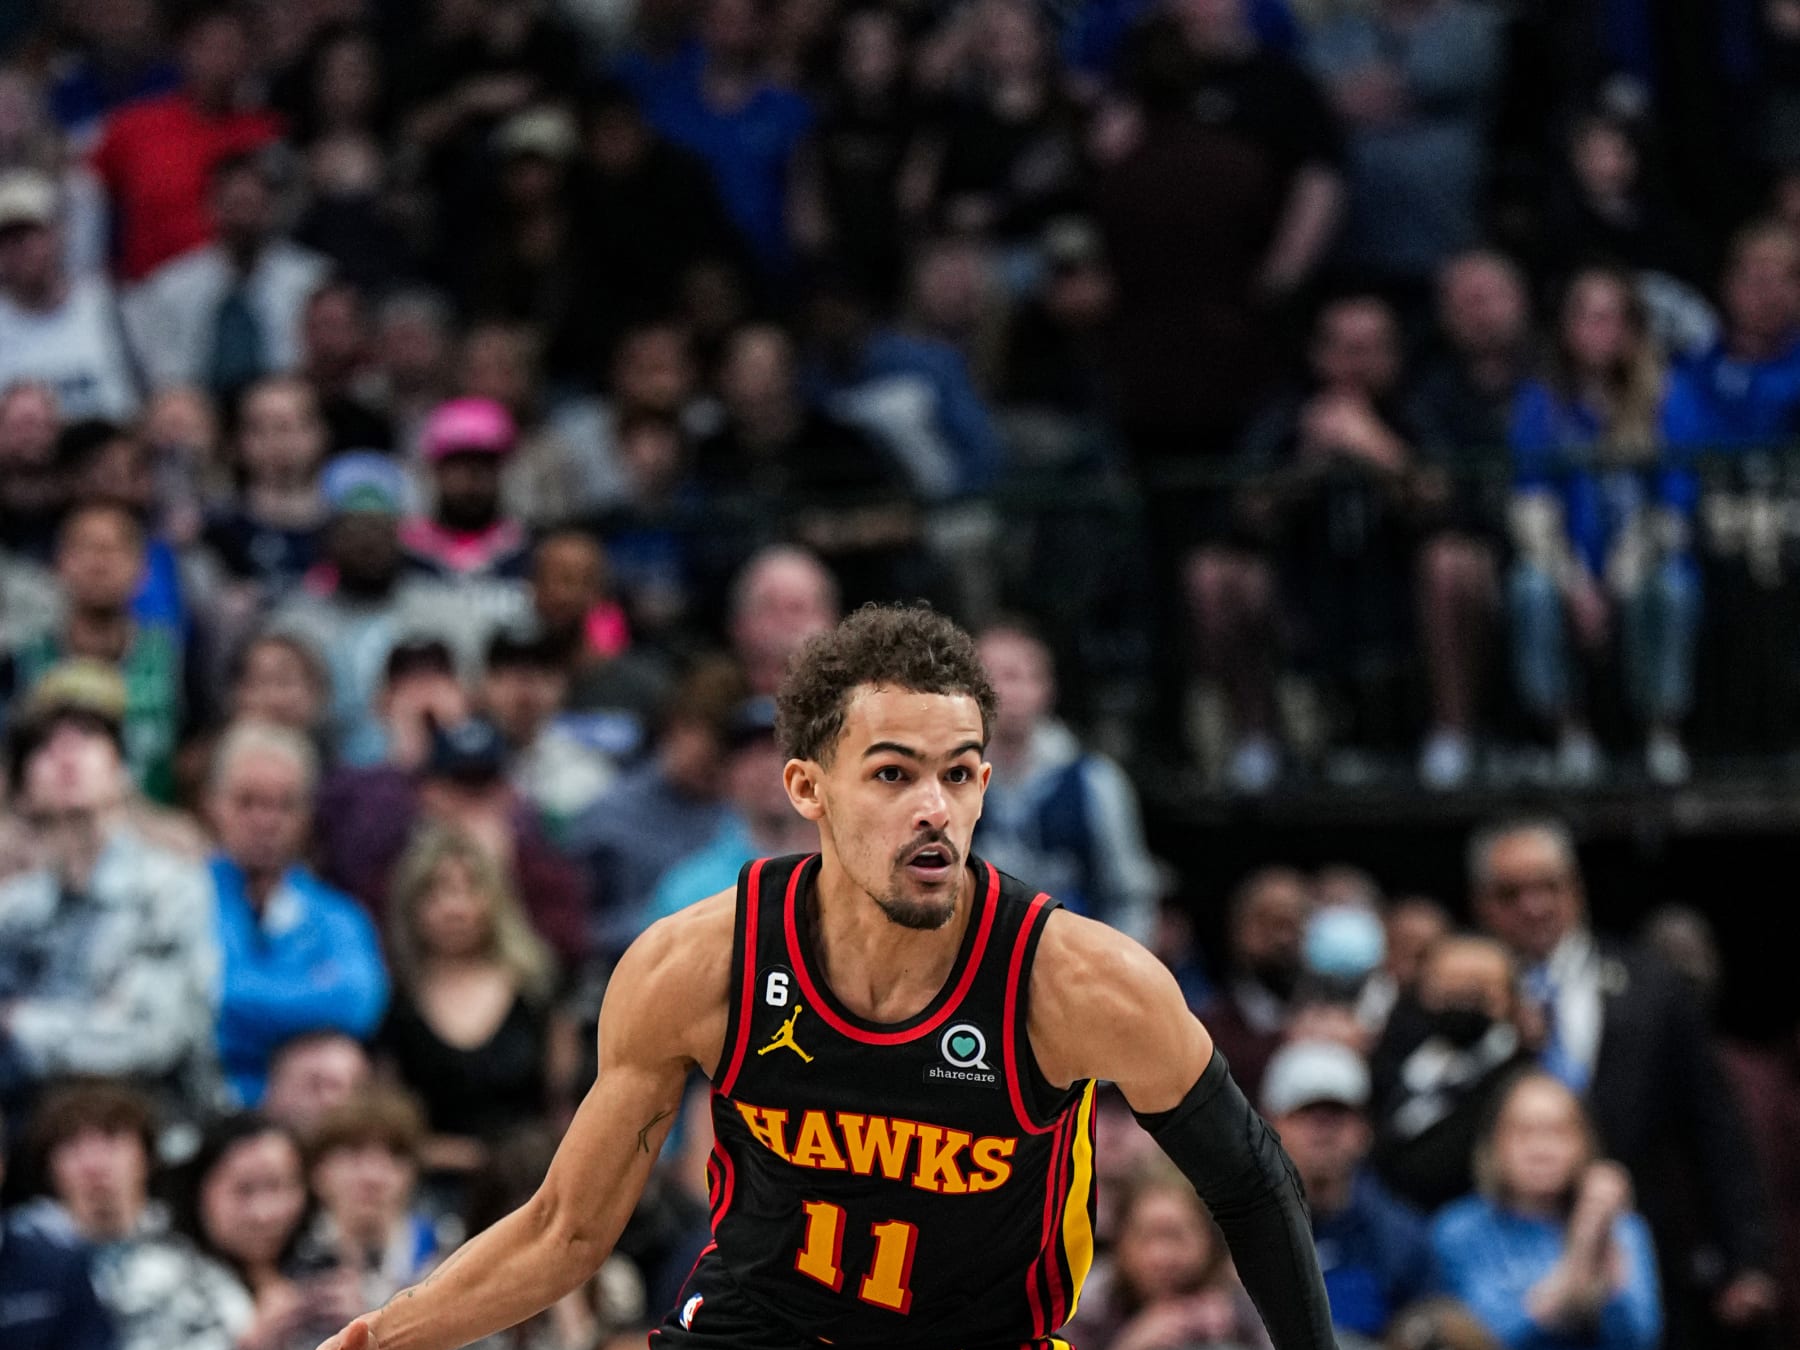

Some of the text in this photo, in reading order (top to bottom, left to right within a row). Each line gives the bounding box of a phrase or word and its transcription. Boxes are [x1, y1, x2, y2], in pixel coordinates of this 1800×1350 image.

[766, 972, 789, 1006] 6
[929, 1066, 996, 1083] sharecare
[735, 1100, 1018, 1194] HAWKS
[794, 1199, 919, 1316] 11
